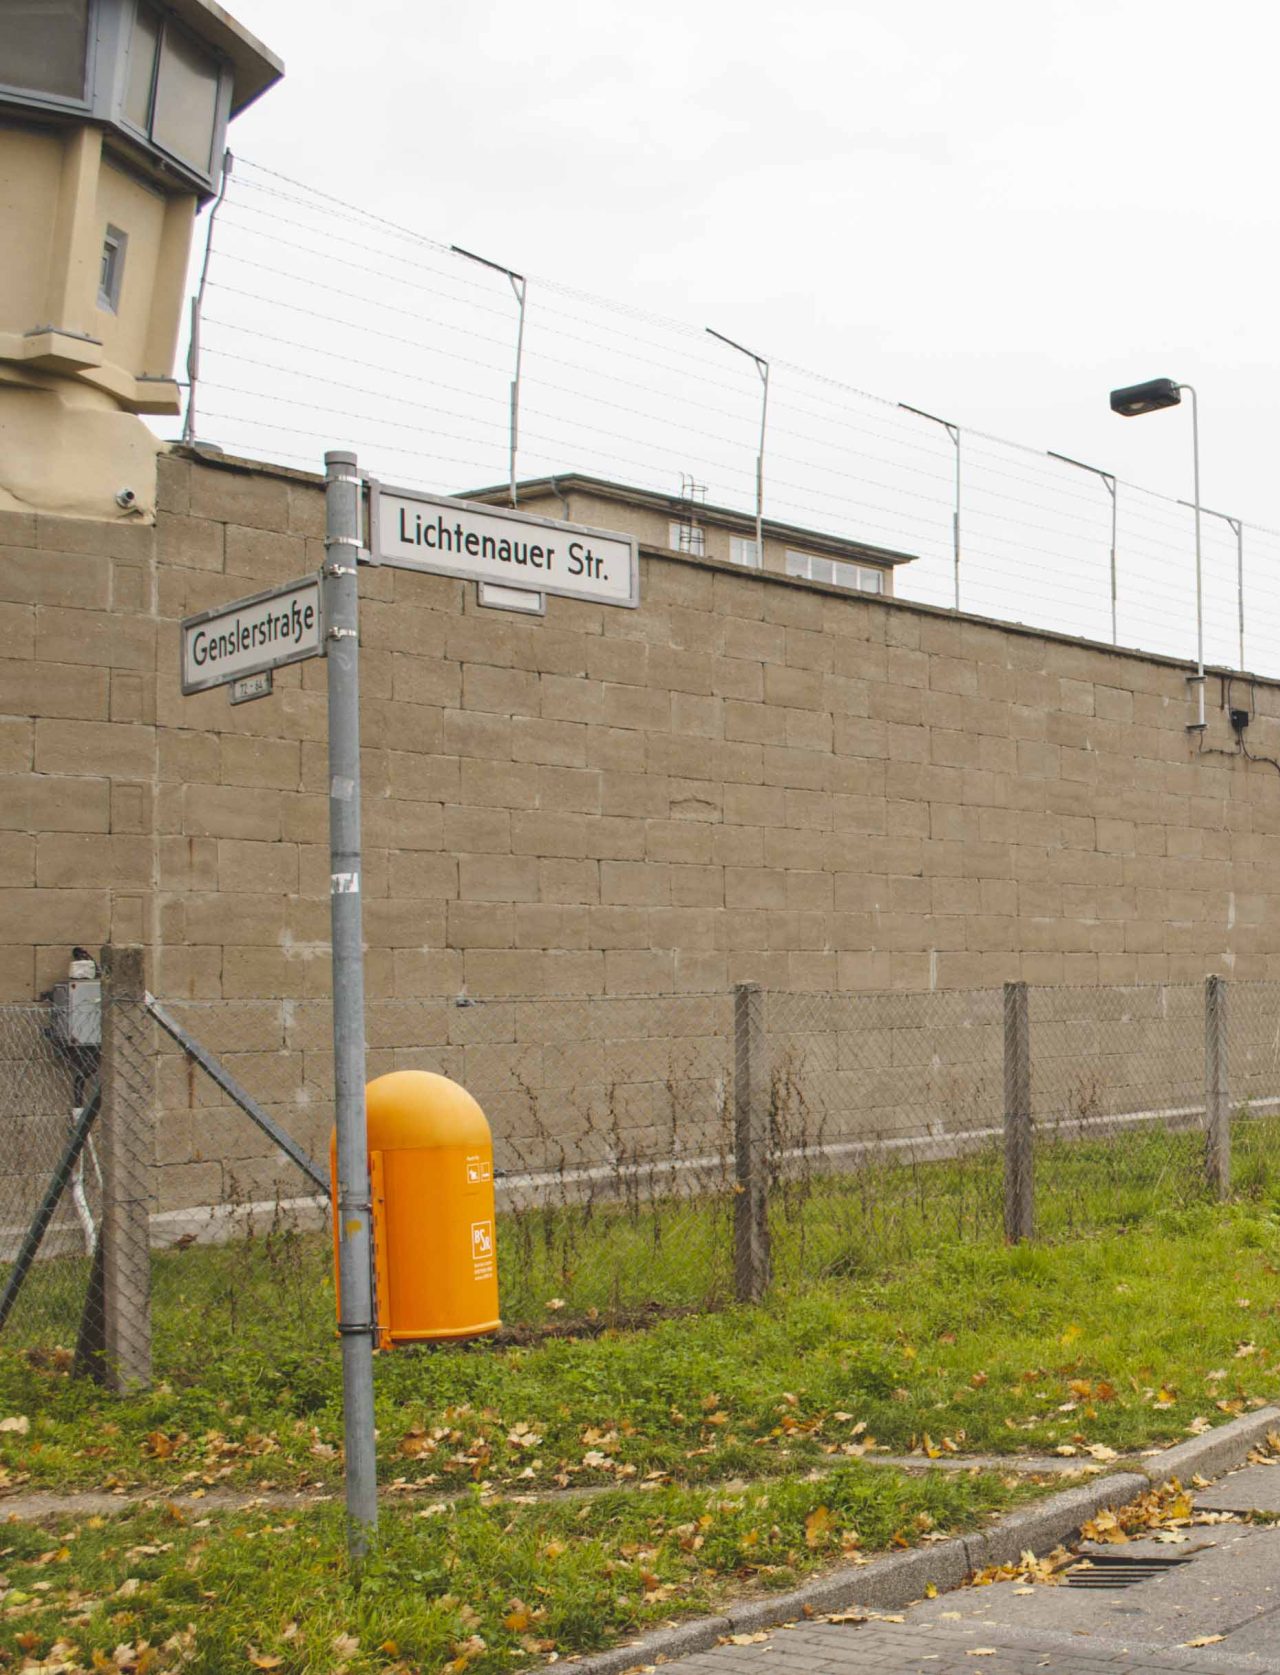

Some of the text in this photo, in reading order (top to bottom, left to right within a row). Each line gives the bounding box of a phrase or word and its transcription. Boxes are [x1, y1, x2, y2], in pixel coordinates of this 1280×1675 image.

[400, 507, 608, 580] Lichtenauer Str.
[193, 600, 314, 666] Genslerstraße
[474, 1228, 491, 1251] BSR
